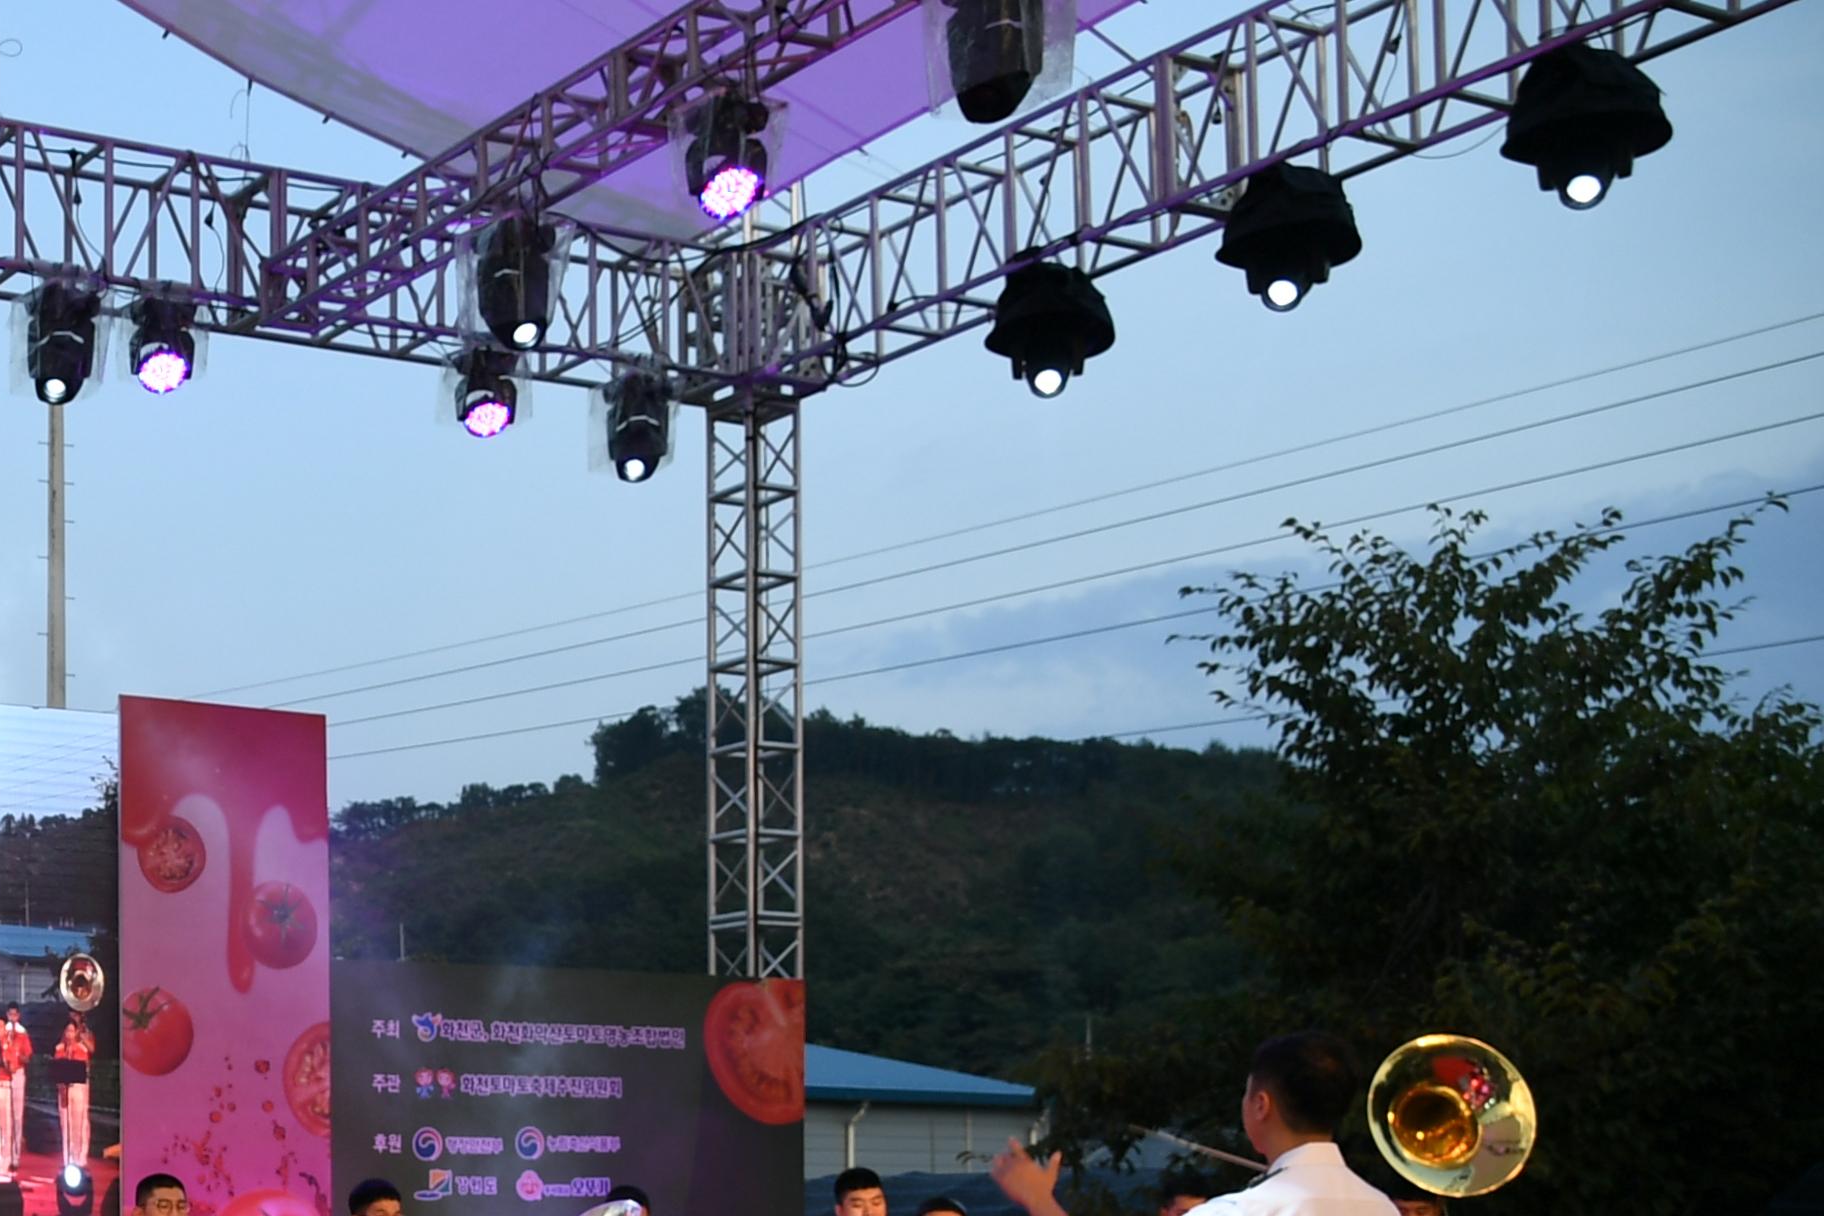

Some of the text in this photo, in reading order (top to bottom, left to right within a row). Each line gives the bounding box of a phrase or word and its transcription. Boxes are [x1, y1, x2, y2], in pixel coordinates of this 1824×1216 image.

[371, 1019, 400, 1039] 주최
[372, 1073, 400, 1092] 주관
[374, 1133, 402, 1153] 후원
